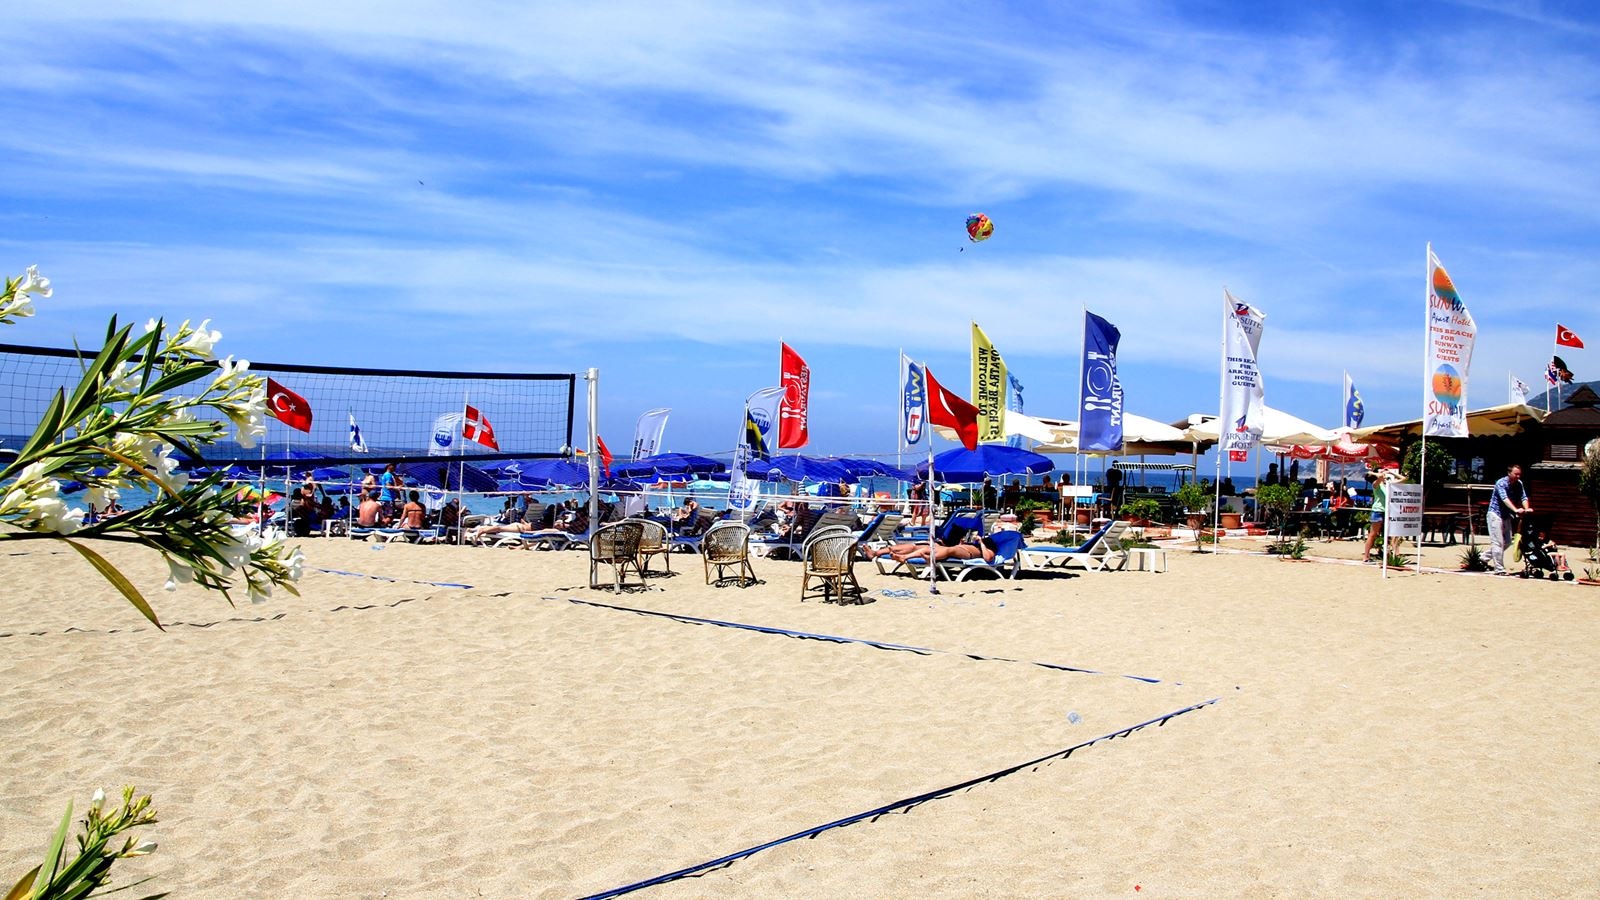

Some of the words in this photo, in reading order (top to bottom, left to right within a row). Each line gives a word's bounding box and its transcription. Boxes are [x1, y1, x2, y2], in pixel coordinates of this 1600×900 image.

[1451, 315, 1472, 327] Hotel
[1444, 328, 1473, 339] BEACH
[1435, 340, 1465, 350] SUNWAY
